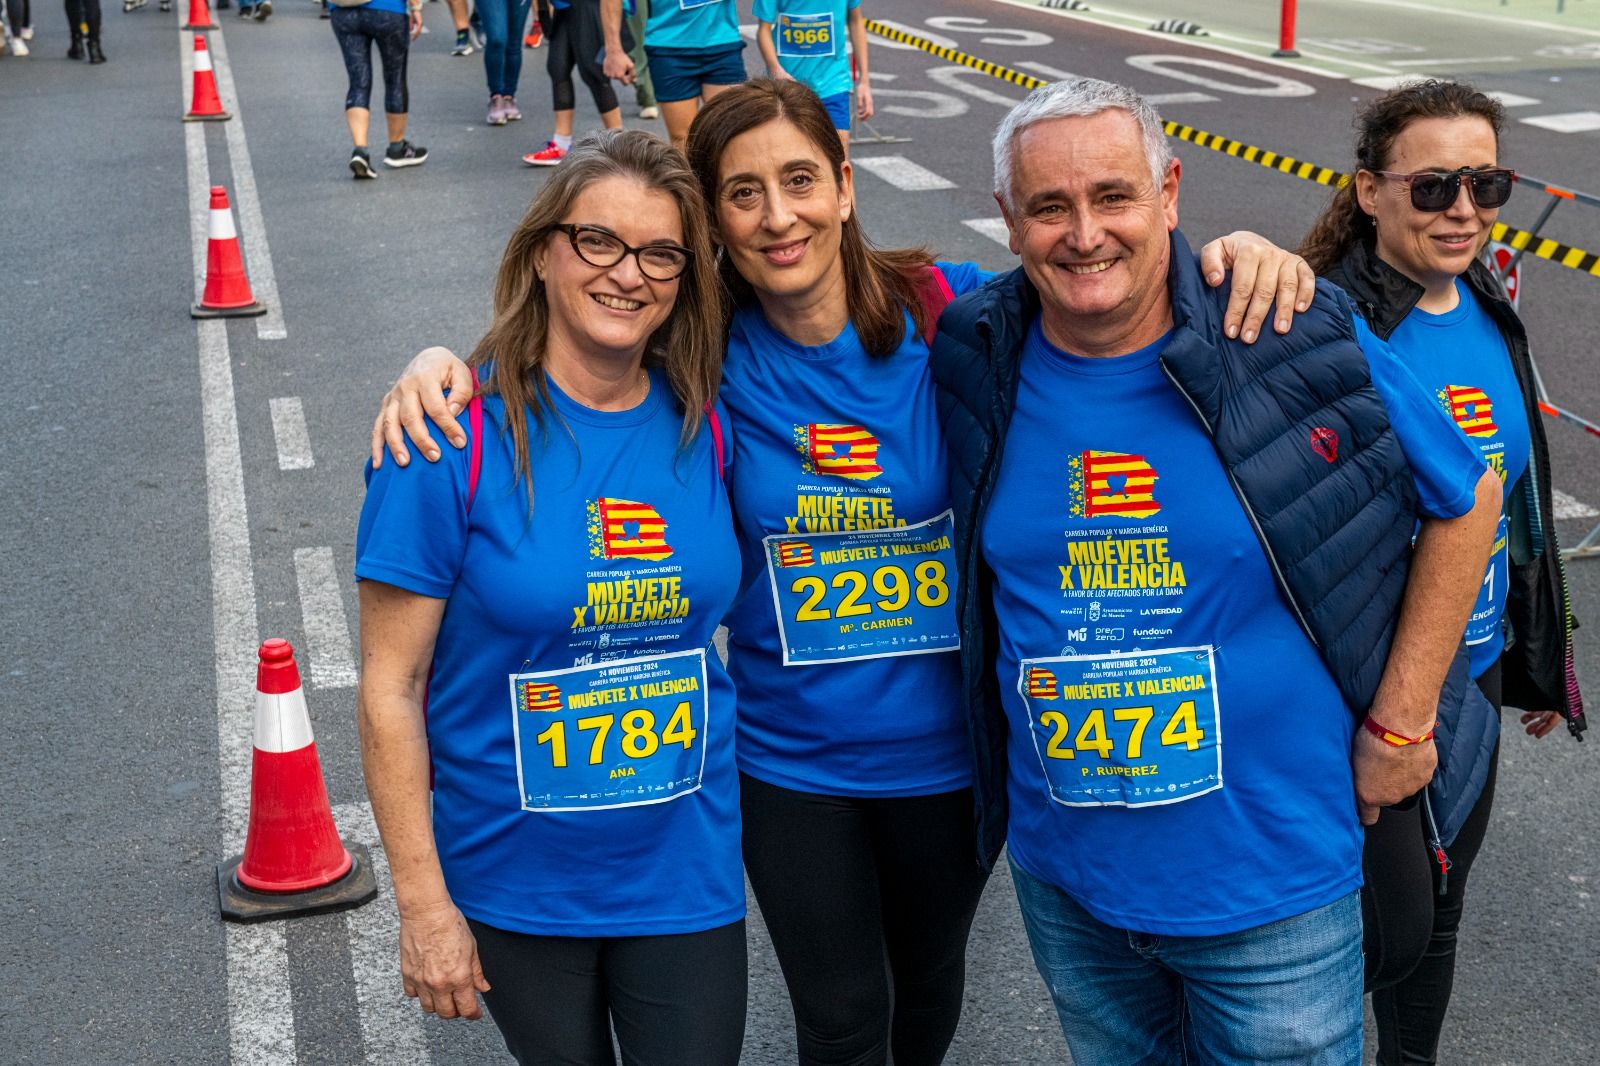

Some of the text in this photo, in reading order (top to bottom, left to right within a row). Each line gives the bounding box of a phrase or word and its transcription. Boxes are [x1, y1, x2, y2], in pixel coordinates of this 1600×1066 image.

[782, 28, 830, 44] 1966
[797, 493, 894, 519] MUÉVETE
[784, 516, 800, 534] X
[1142, 525, 1168, 534] BENÉFICA
[820, 536, 951, 566] MUÉVETE X VALENCIA
[1067, 536, 1170, 565] MUÉVETE
[1059, 562, 1187, 589] X VALENCIA
[587, 576, 681, 606] MUÉVETE
[791, 560, 950, 622] 2298
[1107, 589, 1140, 597] AFECTADOS
[571, 598, 689, 628] X VALENCIA
[862, 616, 913, 631] CARMEN
[608, 665, 642, 676] NOVIEMBRE
[1092, 658, 1156, 670] 24 NOVIEMBRE 2024
[568, 676, 699, 710] MUÉVETE X VALENCIA
[1064, 674, 1206, 700] MUÉVETE X VALENCIA
[536, 700, 697, 768] 1784
[1040, 700, 1205, 760] 2474
[609, 767, 636, 779] ANA
[1081, 765, 1158, 777] P. RUIPEREZ
